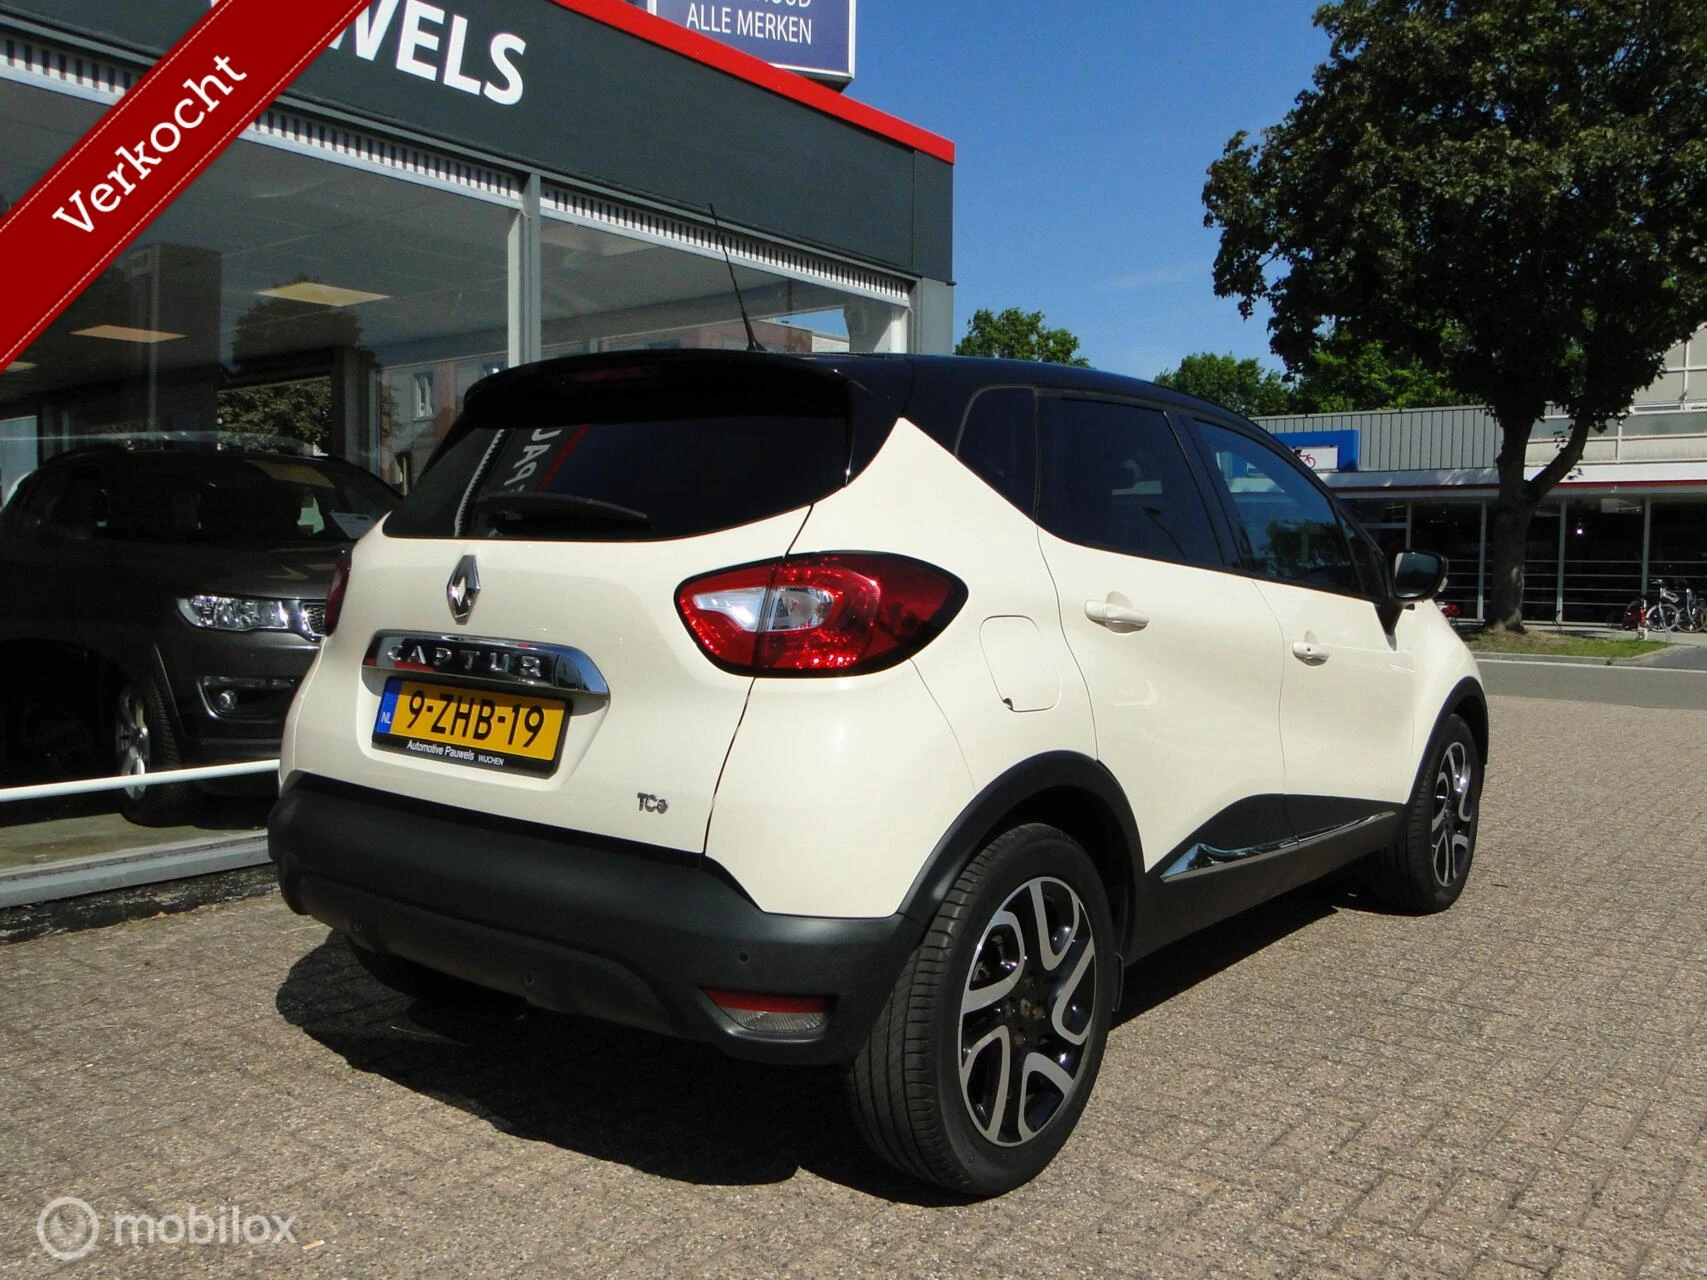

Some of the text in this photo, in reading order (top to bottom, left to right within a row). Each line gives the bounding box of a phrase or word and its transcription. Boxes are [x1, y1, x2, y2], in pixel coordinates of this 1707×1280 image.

[686, 3, 812, 45] ALLE MERKEN
[387, 645, 541, 678] CAPTUR
[381, 711, 391, 724] NL
[405, 690, 545, 748] 9-ZHB-19
[406, 739, 444, 755] Automotive
[444, 745, 475, 761] Pauwels
